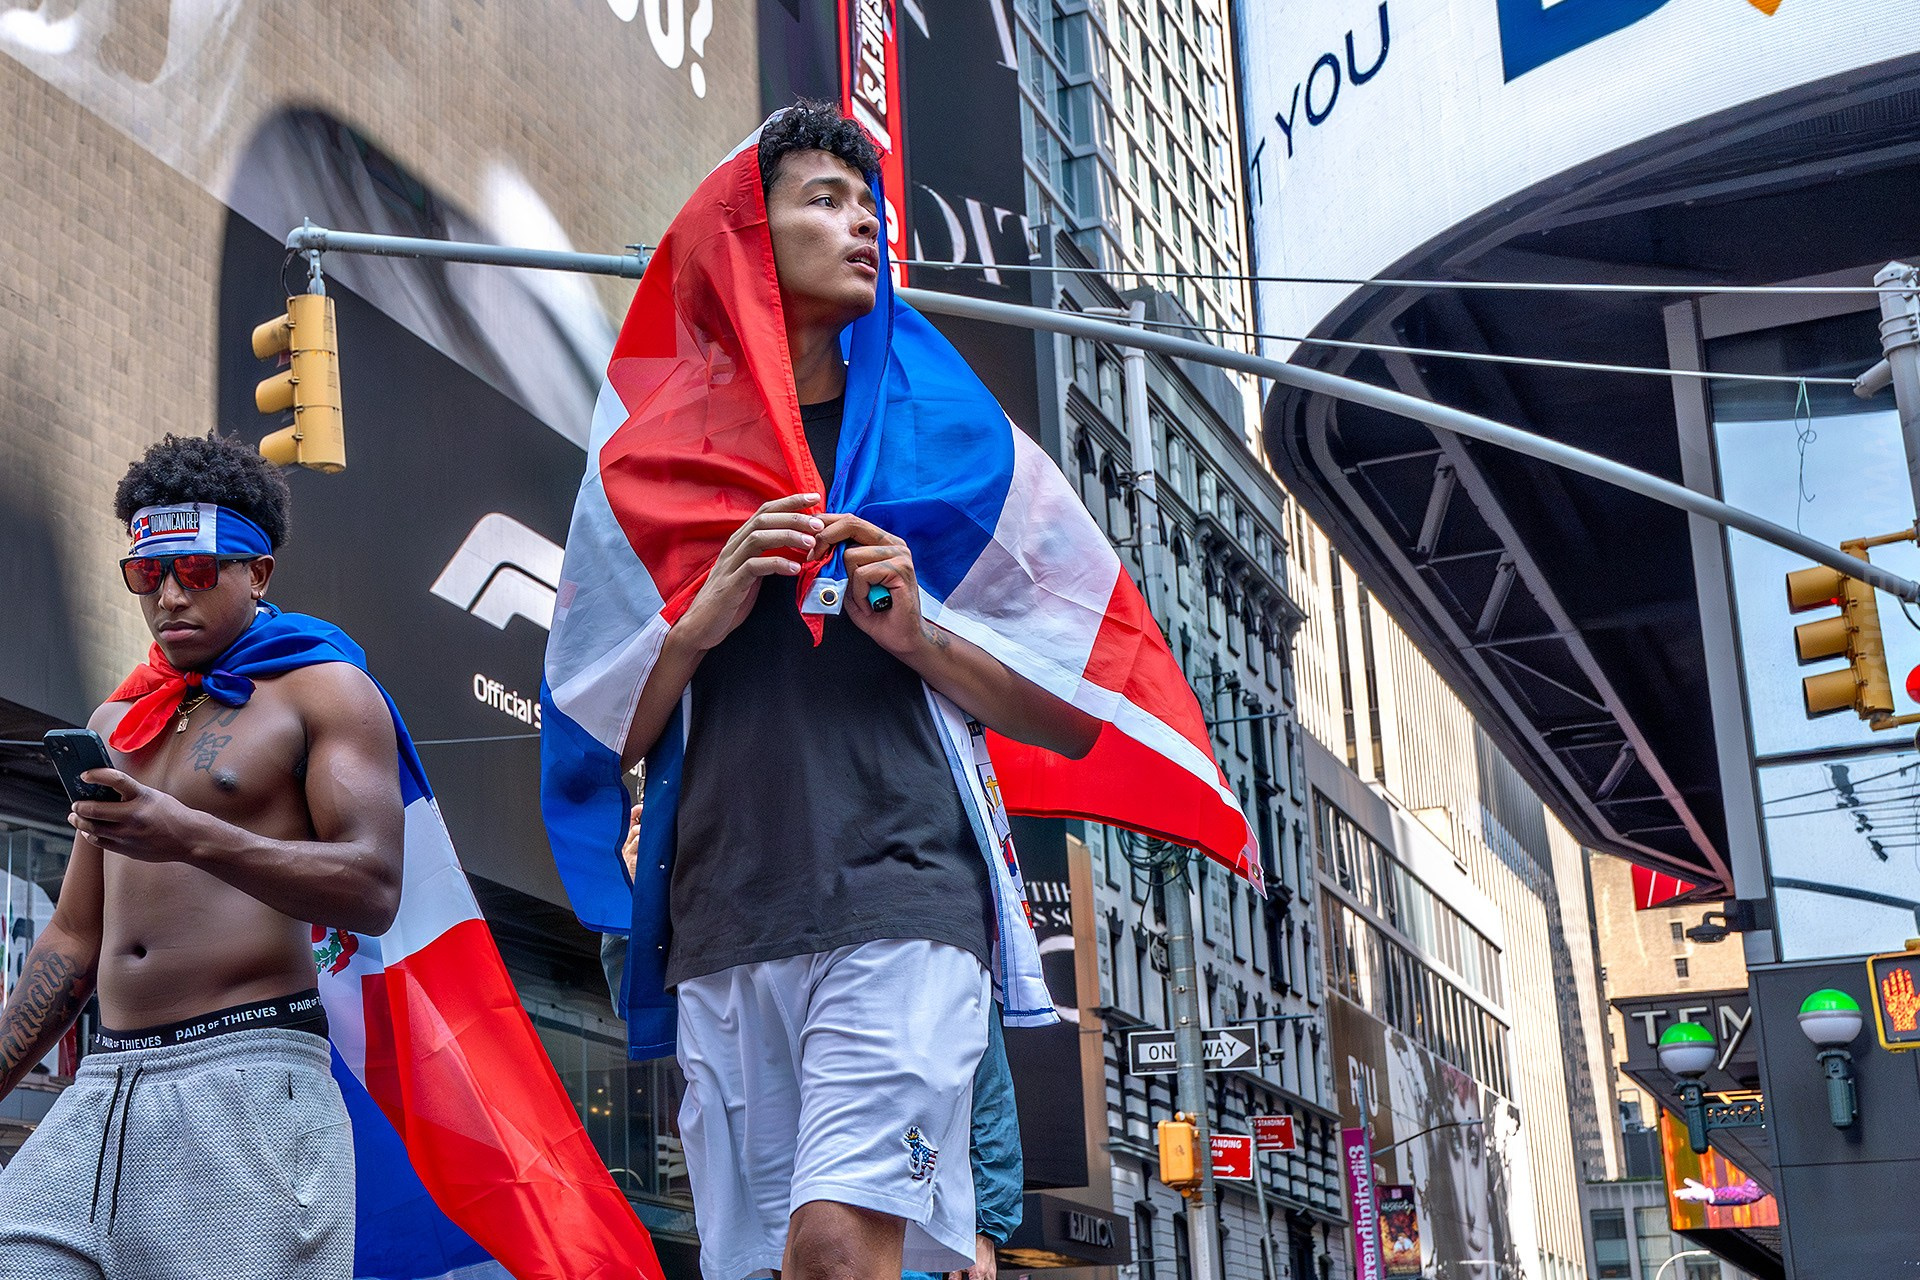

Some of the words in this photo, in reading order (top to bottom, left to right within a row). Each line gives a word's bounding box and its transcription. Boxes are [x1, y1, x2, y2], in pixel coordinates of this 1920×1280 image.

[1275, 1, 1390, 159] YOU
[151, 512, 185, 533] DOMINICAN
[473, 673, 532, 725] Official
[289, 999, 312, 1013] PAIR
[175, 1024, 205, 1041] PAIR
[207, 1020, 219, 1030] OF
[221, 1006, 277, 1027] THIEVES
[101, 1035, 113, 1049] PAIR
[120, 1035, 162, 1050] THIEVES
[1211, 1139, 1242, 1149] ANDING
[1069, 1210, 1115, 1249] EDITION
